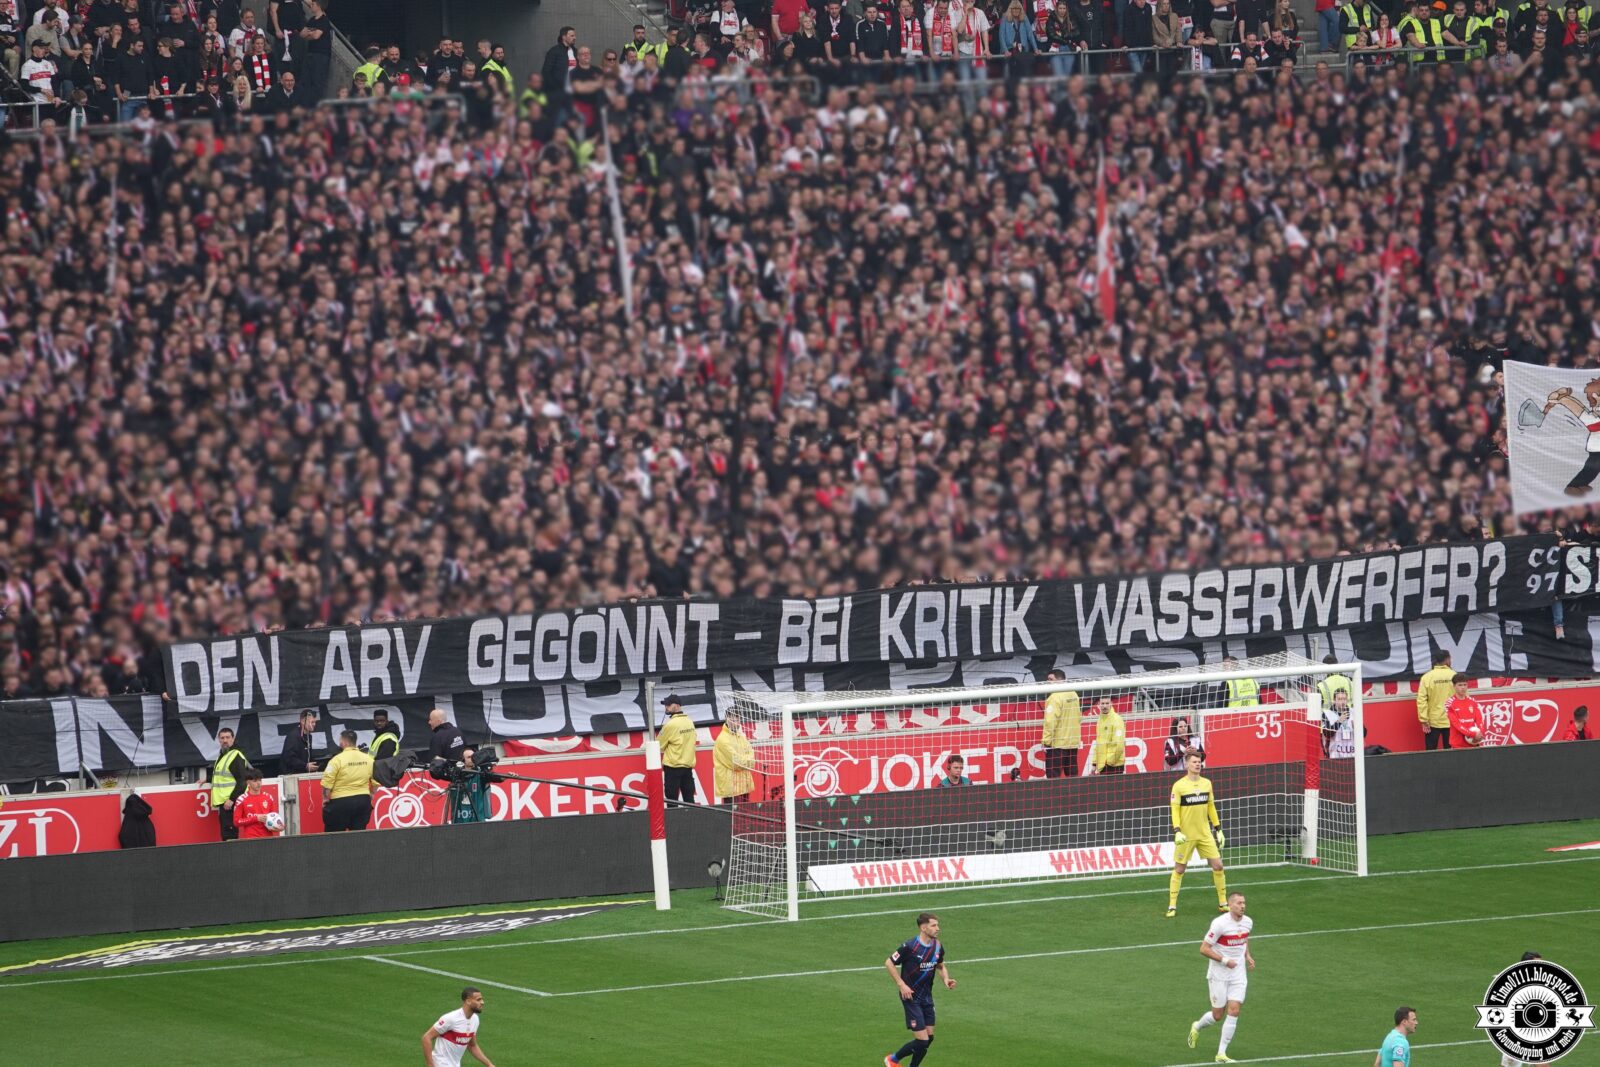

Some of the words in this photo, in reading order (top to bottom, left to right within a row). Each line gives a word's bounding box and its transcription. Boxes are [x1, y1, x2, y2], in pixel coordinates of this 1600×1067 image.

[1528, 546, 1560, 568] CC
[1527, 572, 1559, 594] 97
[171, 635, 280, 713] DEN
[319, 625, 432, 700] ARV
[468, 602, 720, 686] GEGÖNNT
[777, 596, 851, 664] BEI
[880, 585, 1038, 660] KRITIK
[1074, 541, 1506, 648] WASSERWERFER?
[1255, 713, 1282, 739] 35
[859, 736, 1148, 796] JOKERSR
[196, 791, 210, 818] 3
[851, 857, 969, 887] WINAMAX
[1049, 844, 1166, 873] WINAMAX
